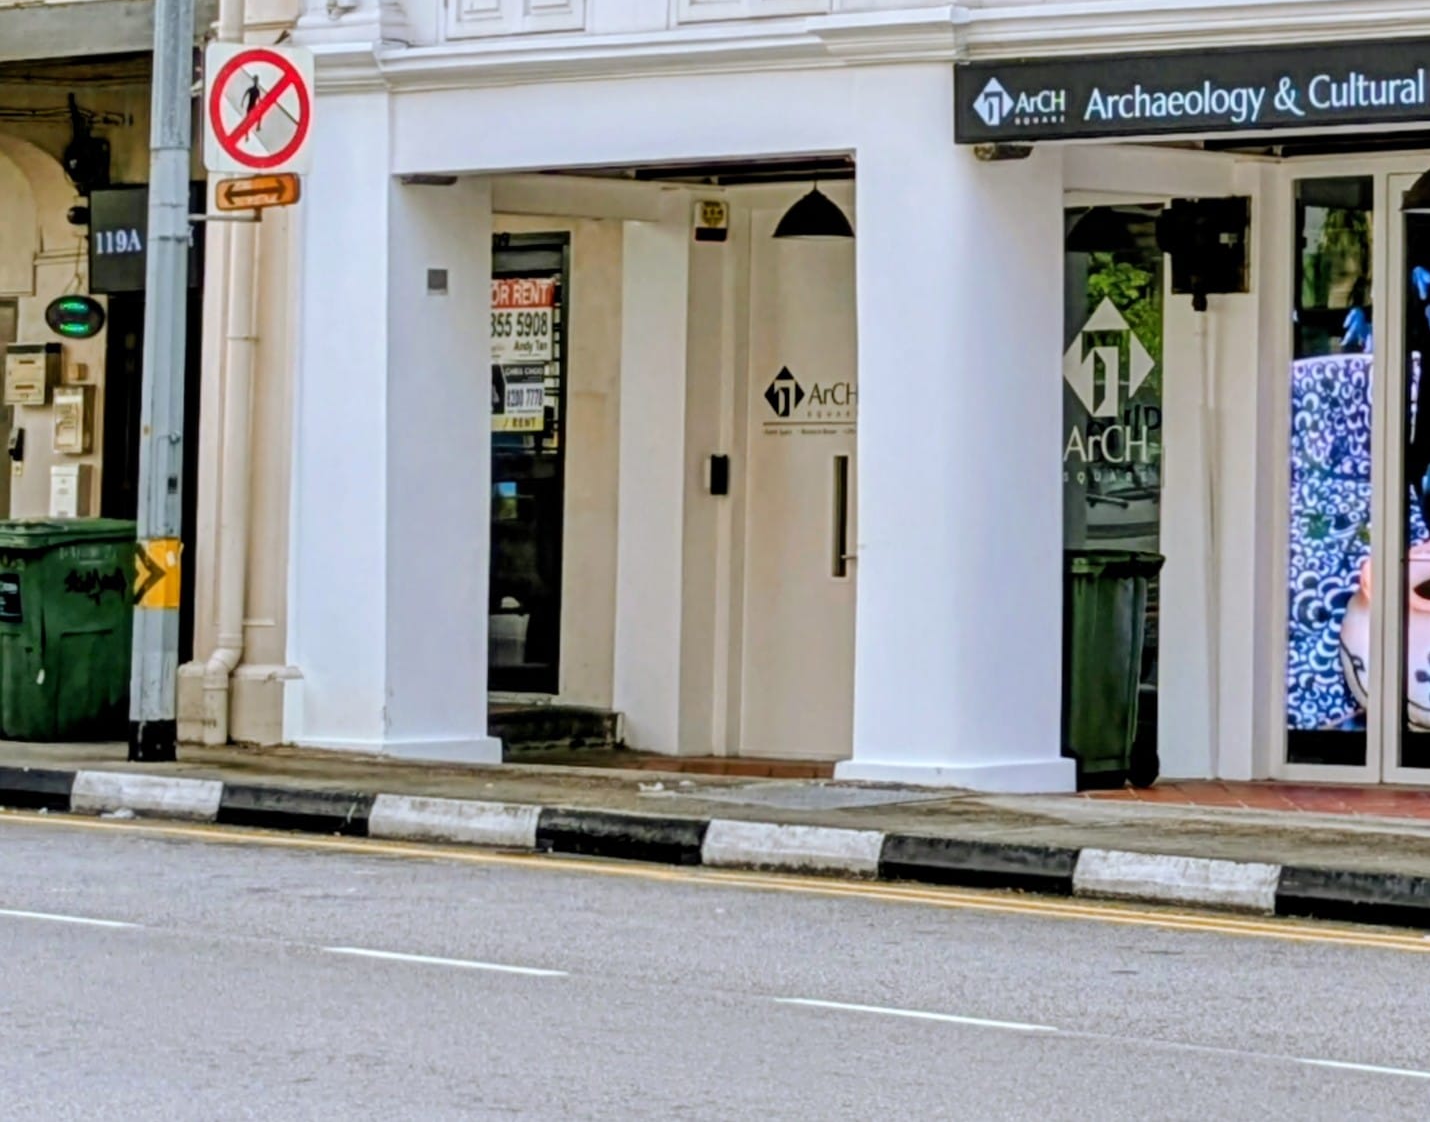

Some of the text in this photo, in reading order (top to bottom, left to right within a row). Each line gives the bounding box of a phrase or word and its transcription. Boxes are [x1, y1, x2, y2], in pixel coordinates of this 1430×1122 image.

[1014, 89, 1066, 114] ArCH
[1083, 80, 1266, 123] Archaeology
[1273, 76, 1306, 117] &
[1308, 68, 1425, 109] Cultural
[95, 229, 142, 255] 119A
[491, 280, 548, 306] OR RENT
[491, 311, 548, 338] 355 5908
[807, 381, 857, 406] ArCH
[1063, 424, 1148, 464] ArCH
